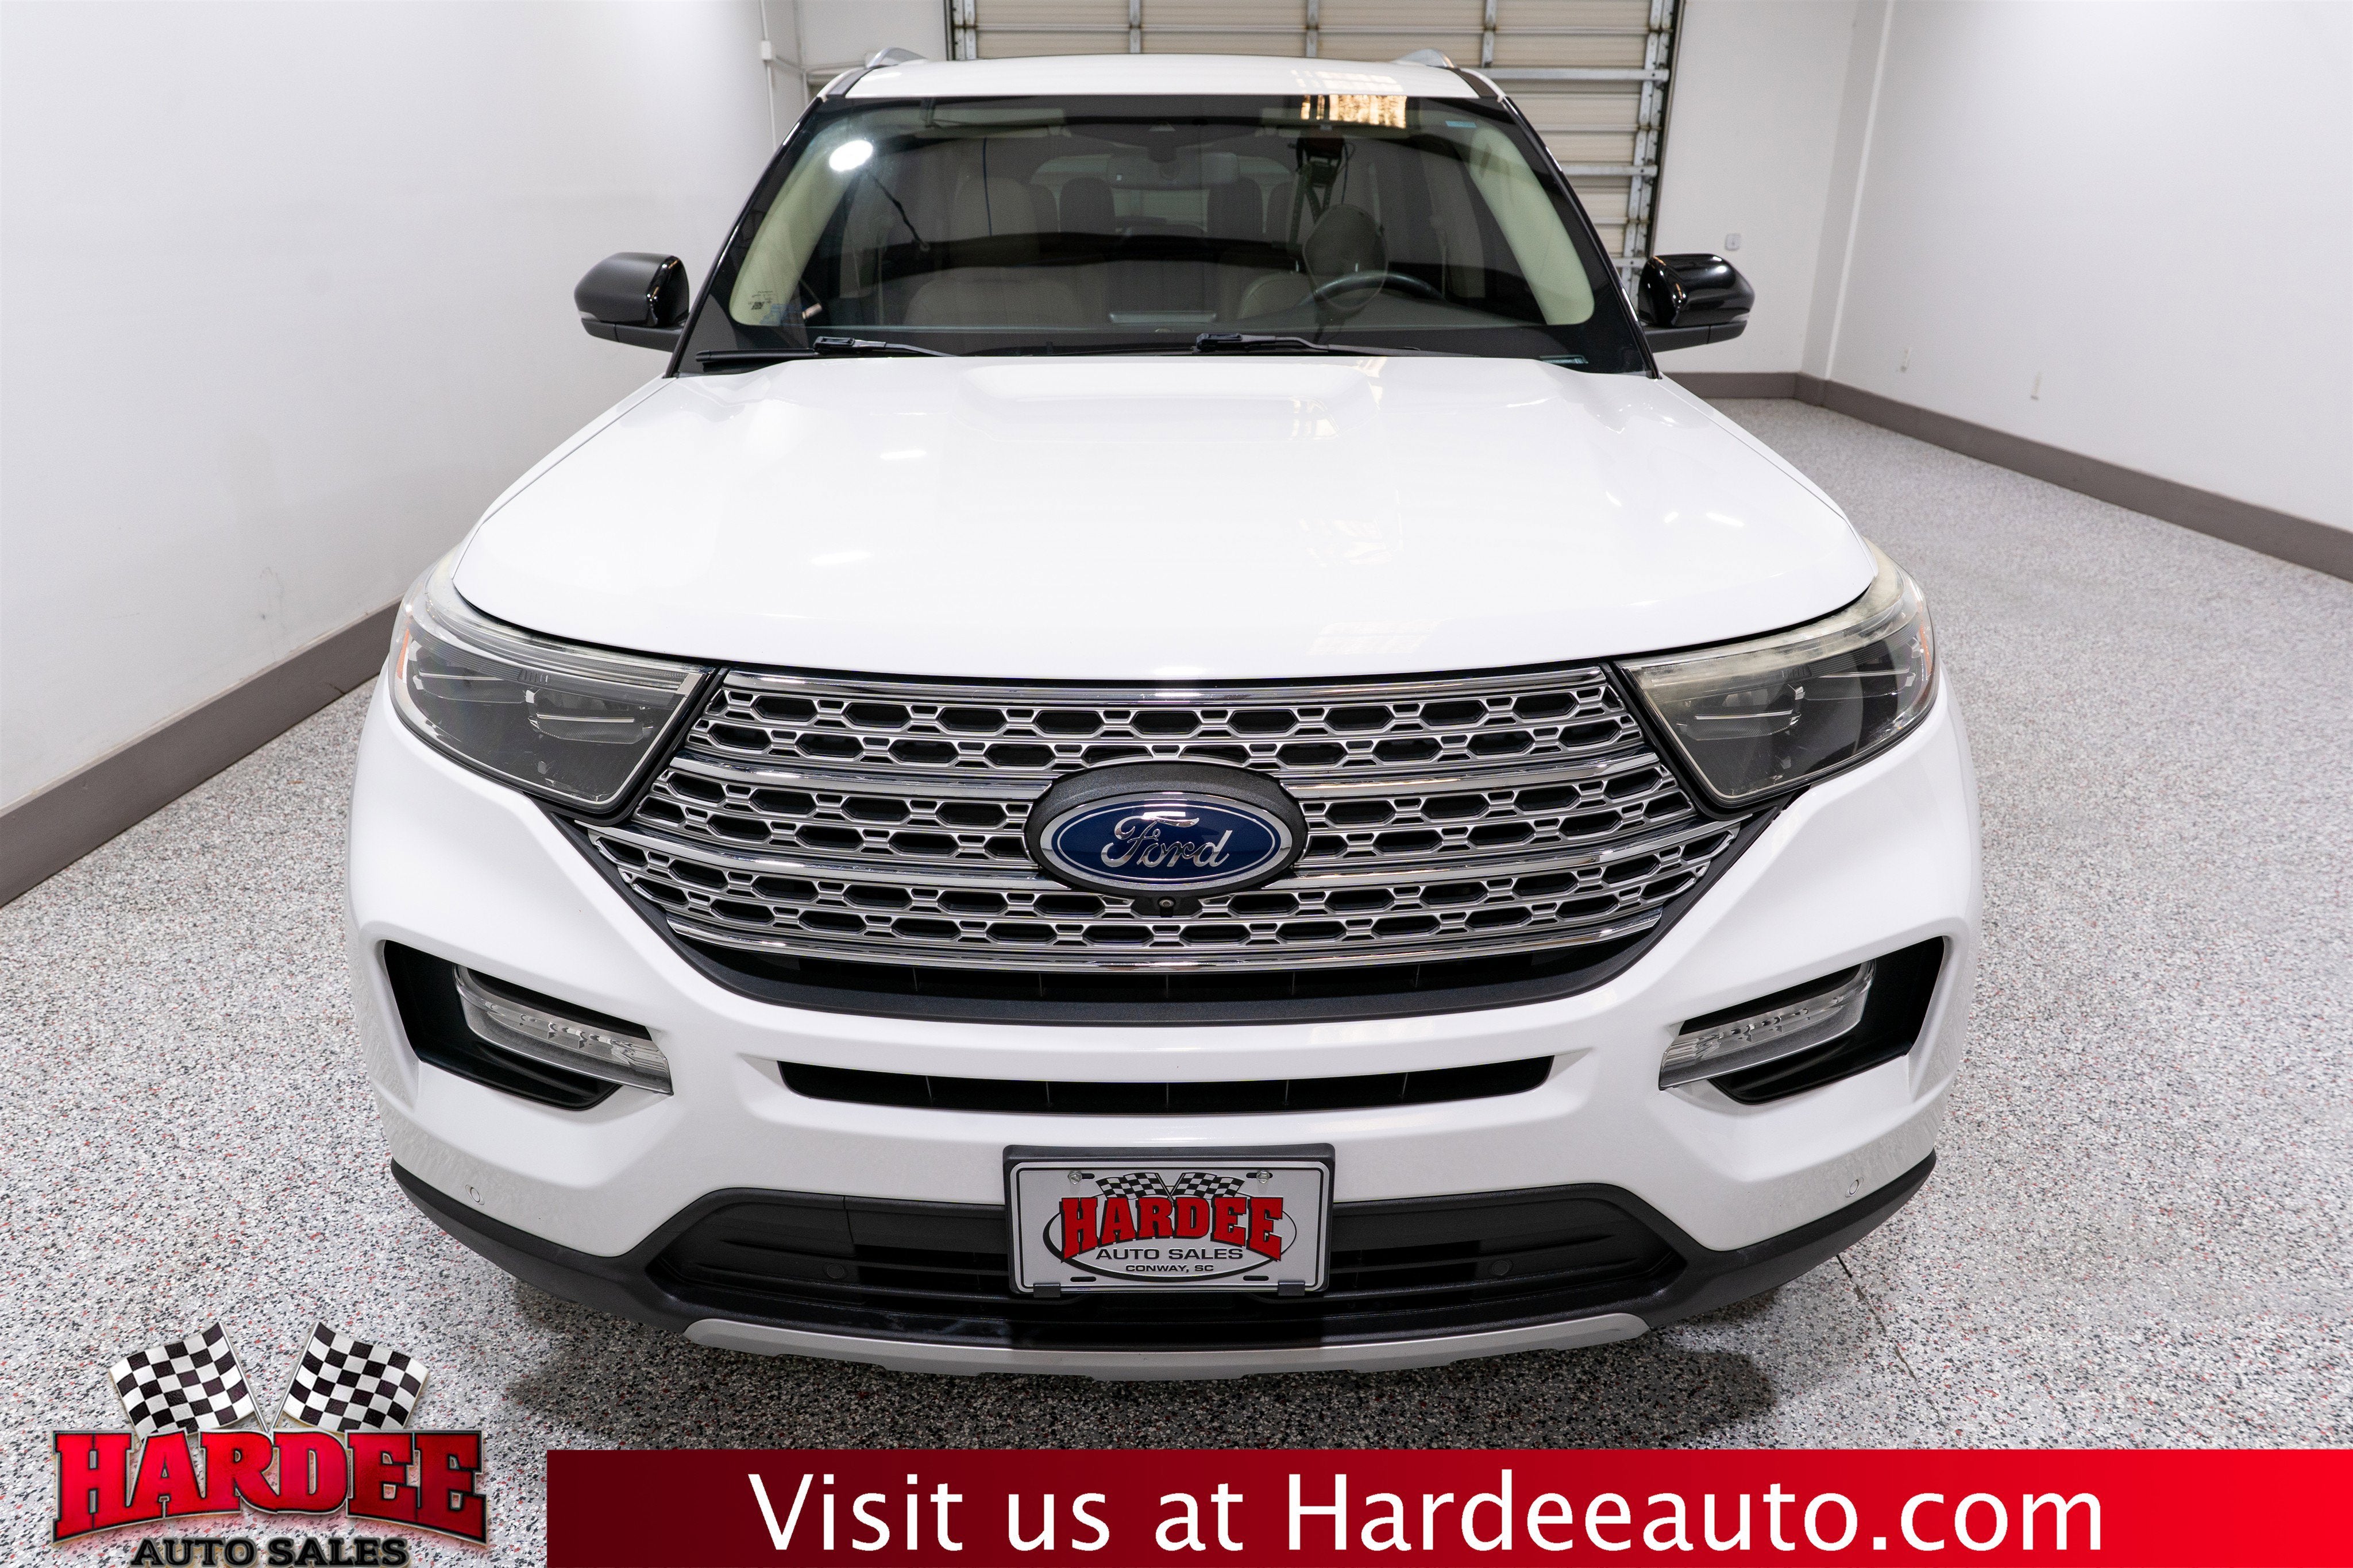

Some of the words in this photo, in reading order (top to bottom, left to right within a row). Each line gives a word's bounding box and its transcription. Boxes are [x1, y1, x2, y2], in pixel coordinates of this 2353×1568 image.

[1101, 813, 1233, 867] Ford
[1059, 1196, 1283, 1262] HARDEE
[1095, 1248, 1160, 1260] AUTO
[1168, 1248, 1244, 1260] SALES
[1125, 1264, 1189, 1273] CONWAY,
[1194, 1264, 1214, 1272] SC
